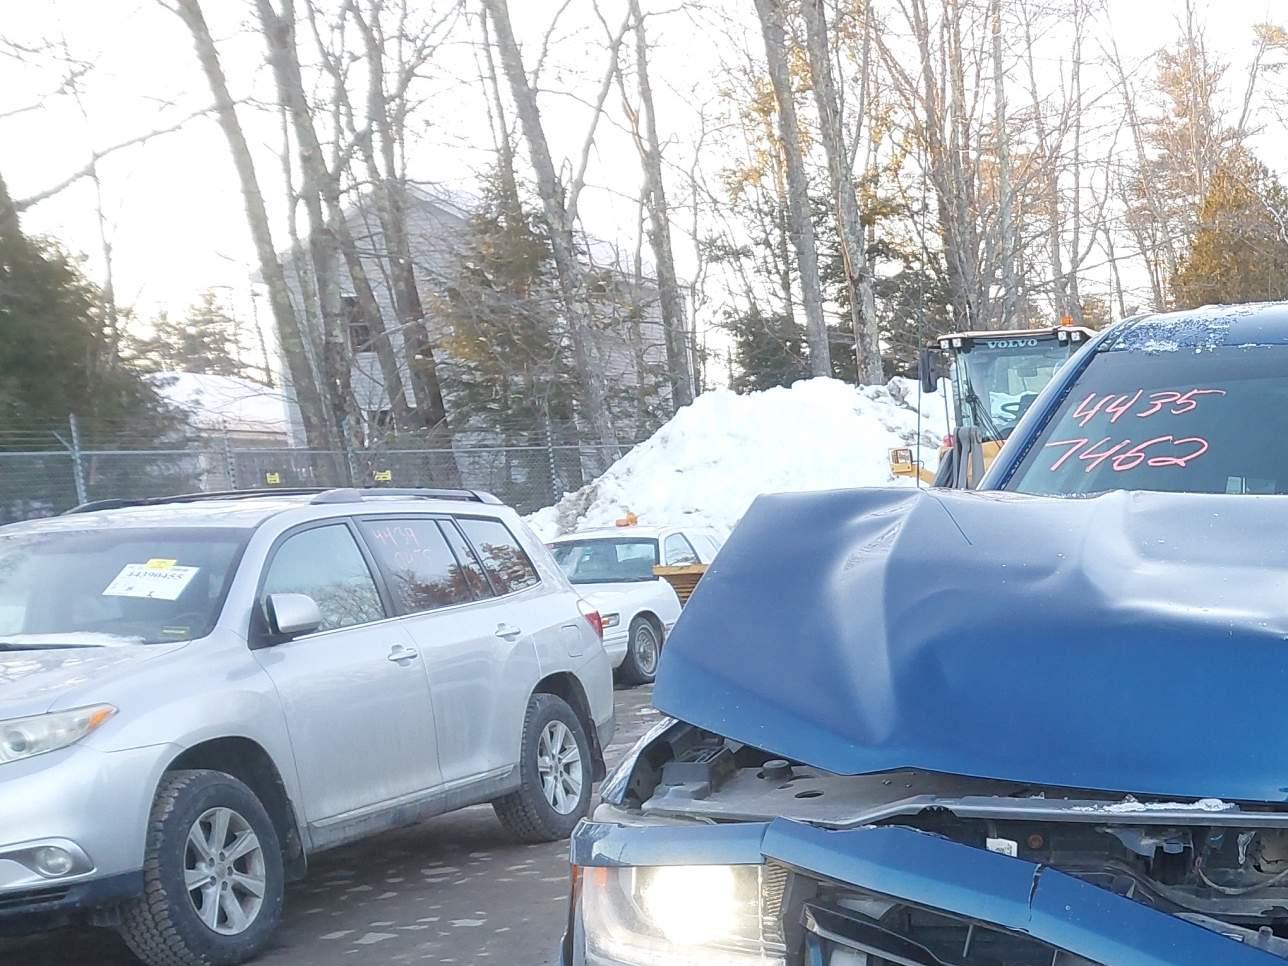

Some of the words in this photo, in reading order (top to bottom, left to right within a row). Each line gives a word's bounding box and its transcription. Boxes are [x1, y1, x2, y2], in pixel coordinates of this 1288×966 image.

[987, 338, 1038, 349] VOLVO
[1072, 389, 1226, 428] 4435
[1045, 435, 1208, 473] 7462
